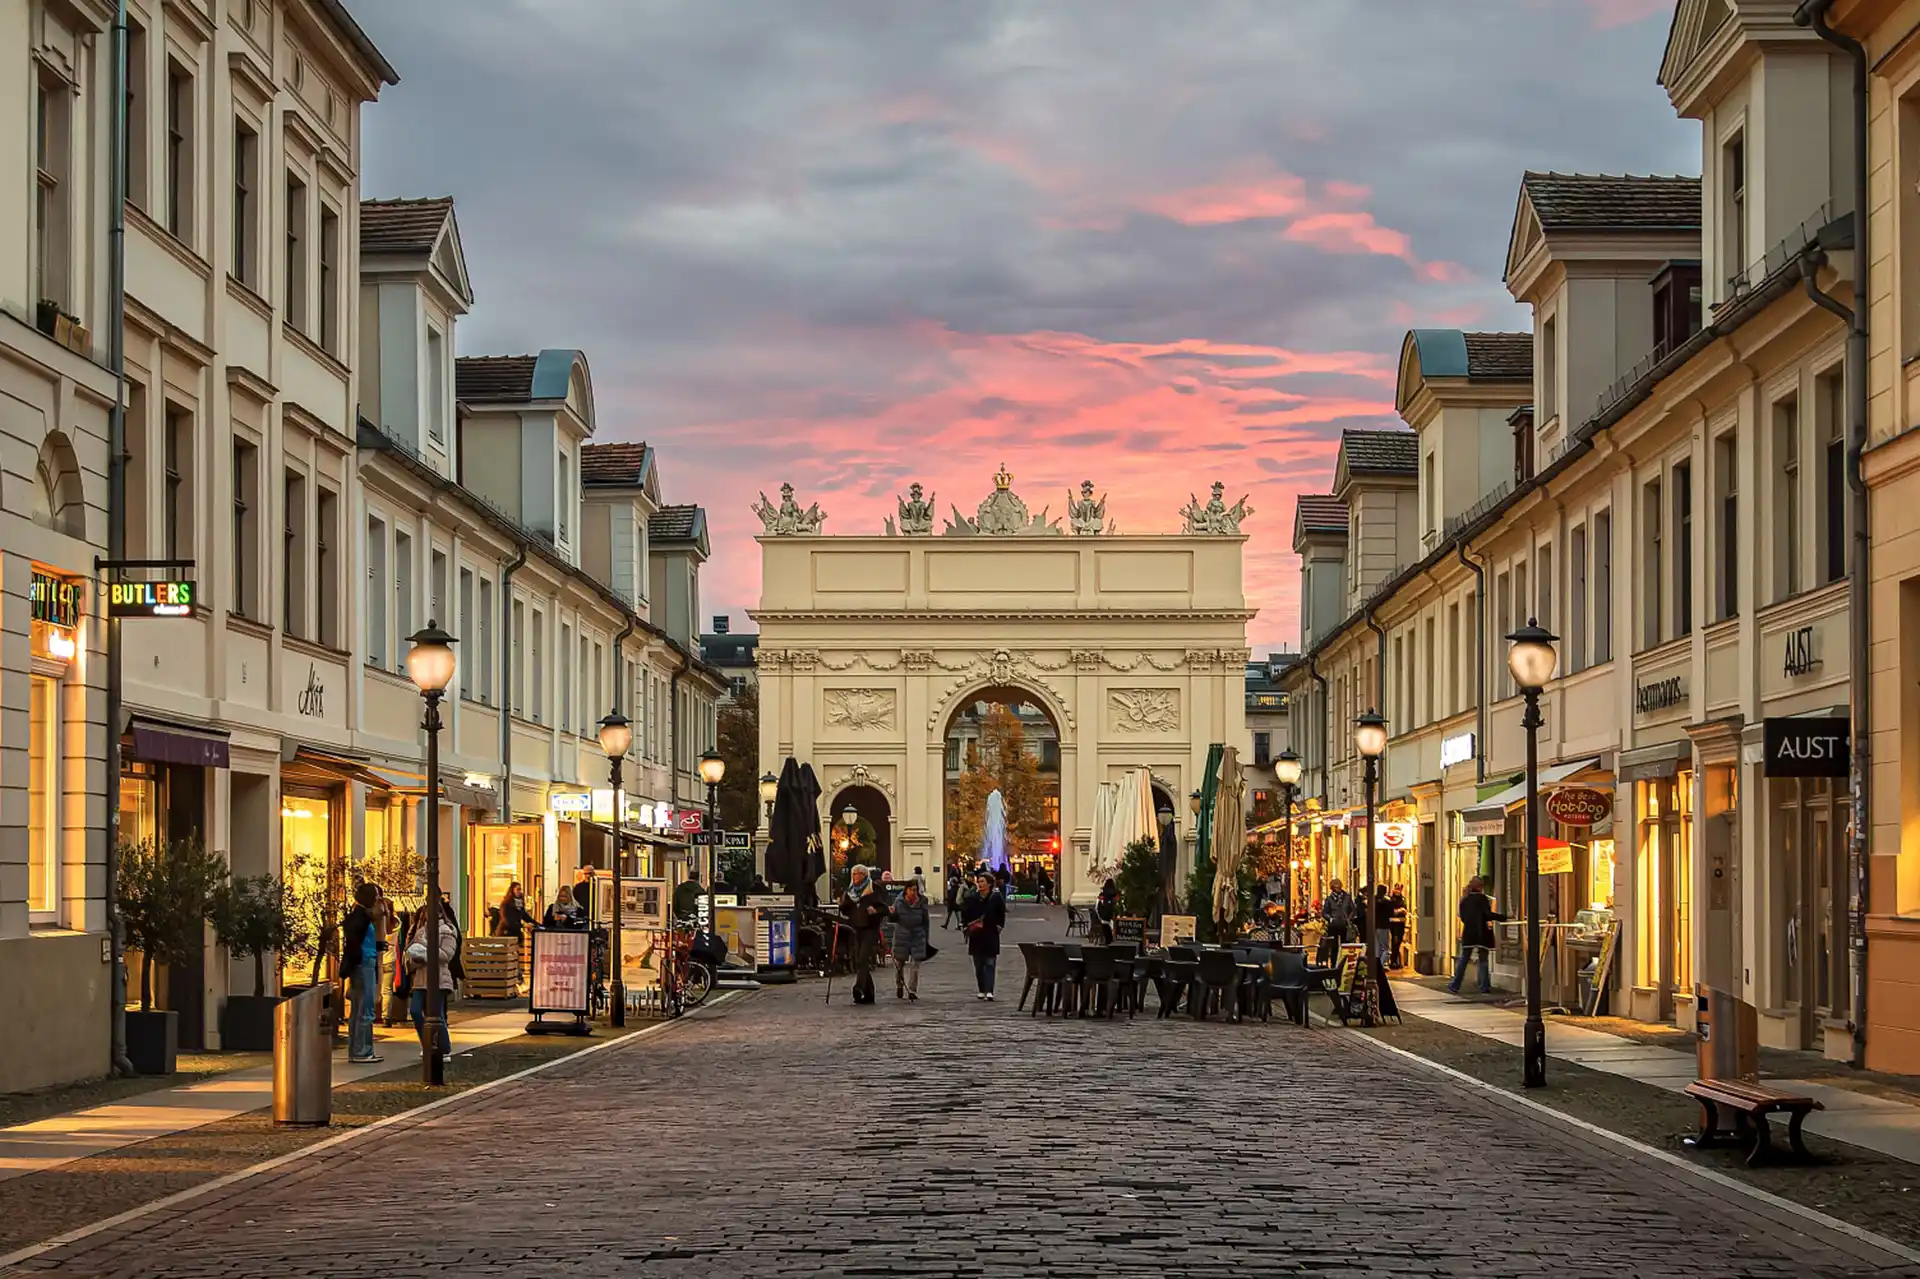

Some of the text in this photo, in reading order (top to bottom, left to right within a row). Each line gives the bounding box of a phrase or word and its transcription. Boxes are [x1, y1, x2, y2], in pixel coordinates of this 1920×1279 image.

[111, 583, 190, 605] BUTLERS
[1784, 626, 1813, 679] AUST
[1777, 736, 1839, 759] AUST
[725, 836, 745, 846] KPM
